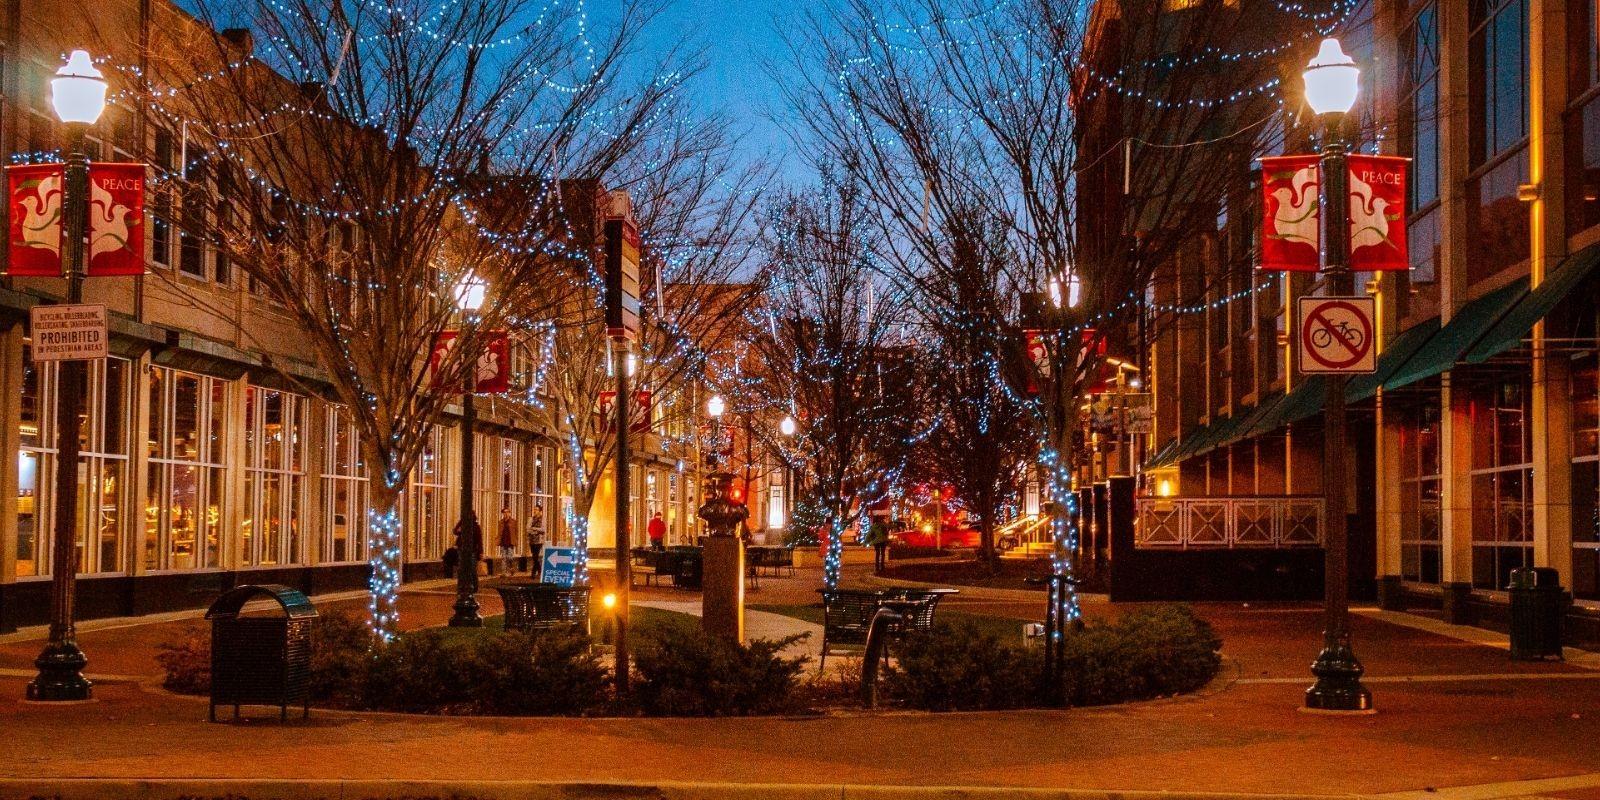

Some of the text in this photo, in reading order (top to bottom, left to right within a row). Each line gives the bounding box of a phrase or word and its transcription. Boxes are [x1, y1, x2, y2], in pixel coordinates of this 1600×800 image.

[1362, 170, 1401, 184] PEACE
[103, 178, 140, 190] PEACE
[41, 331, 99, 344] PROHIBITED
[46, 344, 82, 352] PEDESTRIAN
[84, 343, 103, 351] AREAS
[544, 575, 571, 583] EVENT
